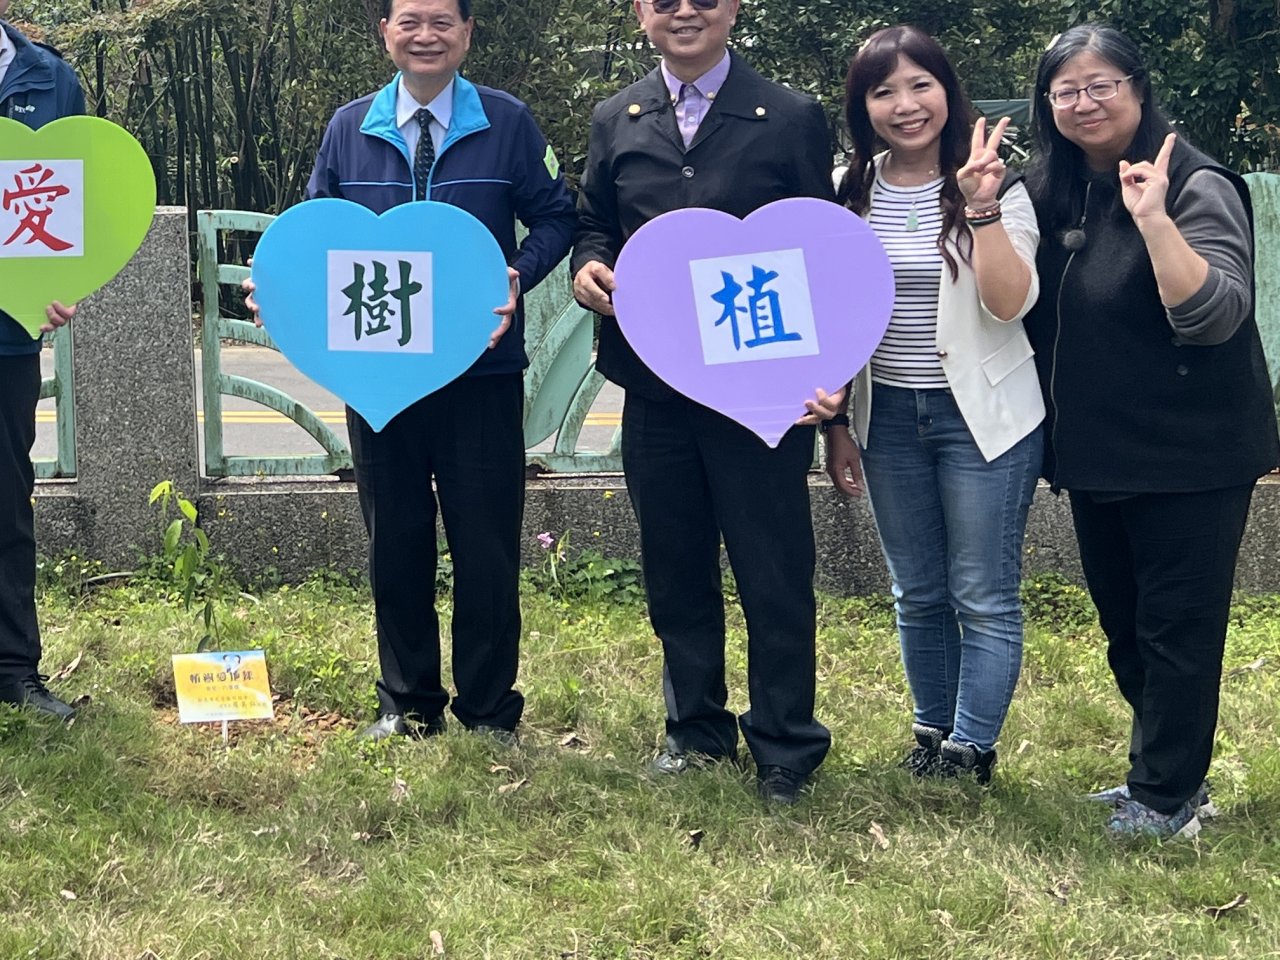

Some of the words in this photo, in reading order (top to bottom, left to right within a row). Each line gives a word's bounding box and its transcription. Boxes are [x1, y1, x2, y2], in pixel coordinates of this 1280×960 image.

[2, 162, 75, 252] 愛
[340, 259, 423, 347] 樹
[710, 264, 803, 351] 植
